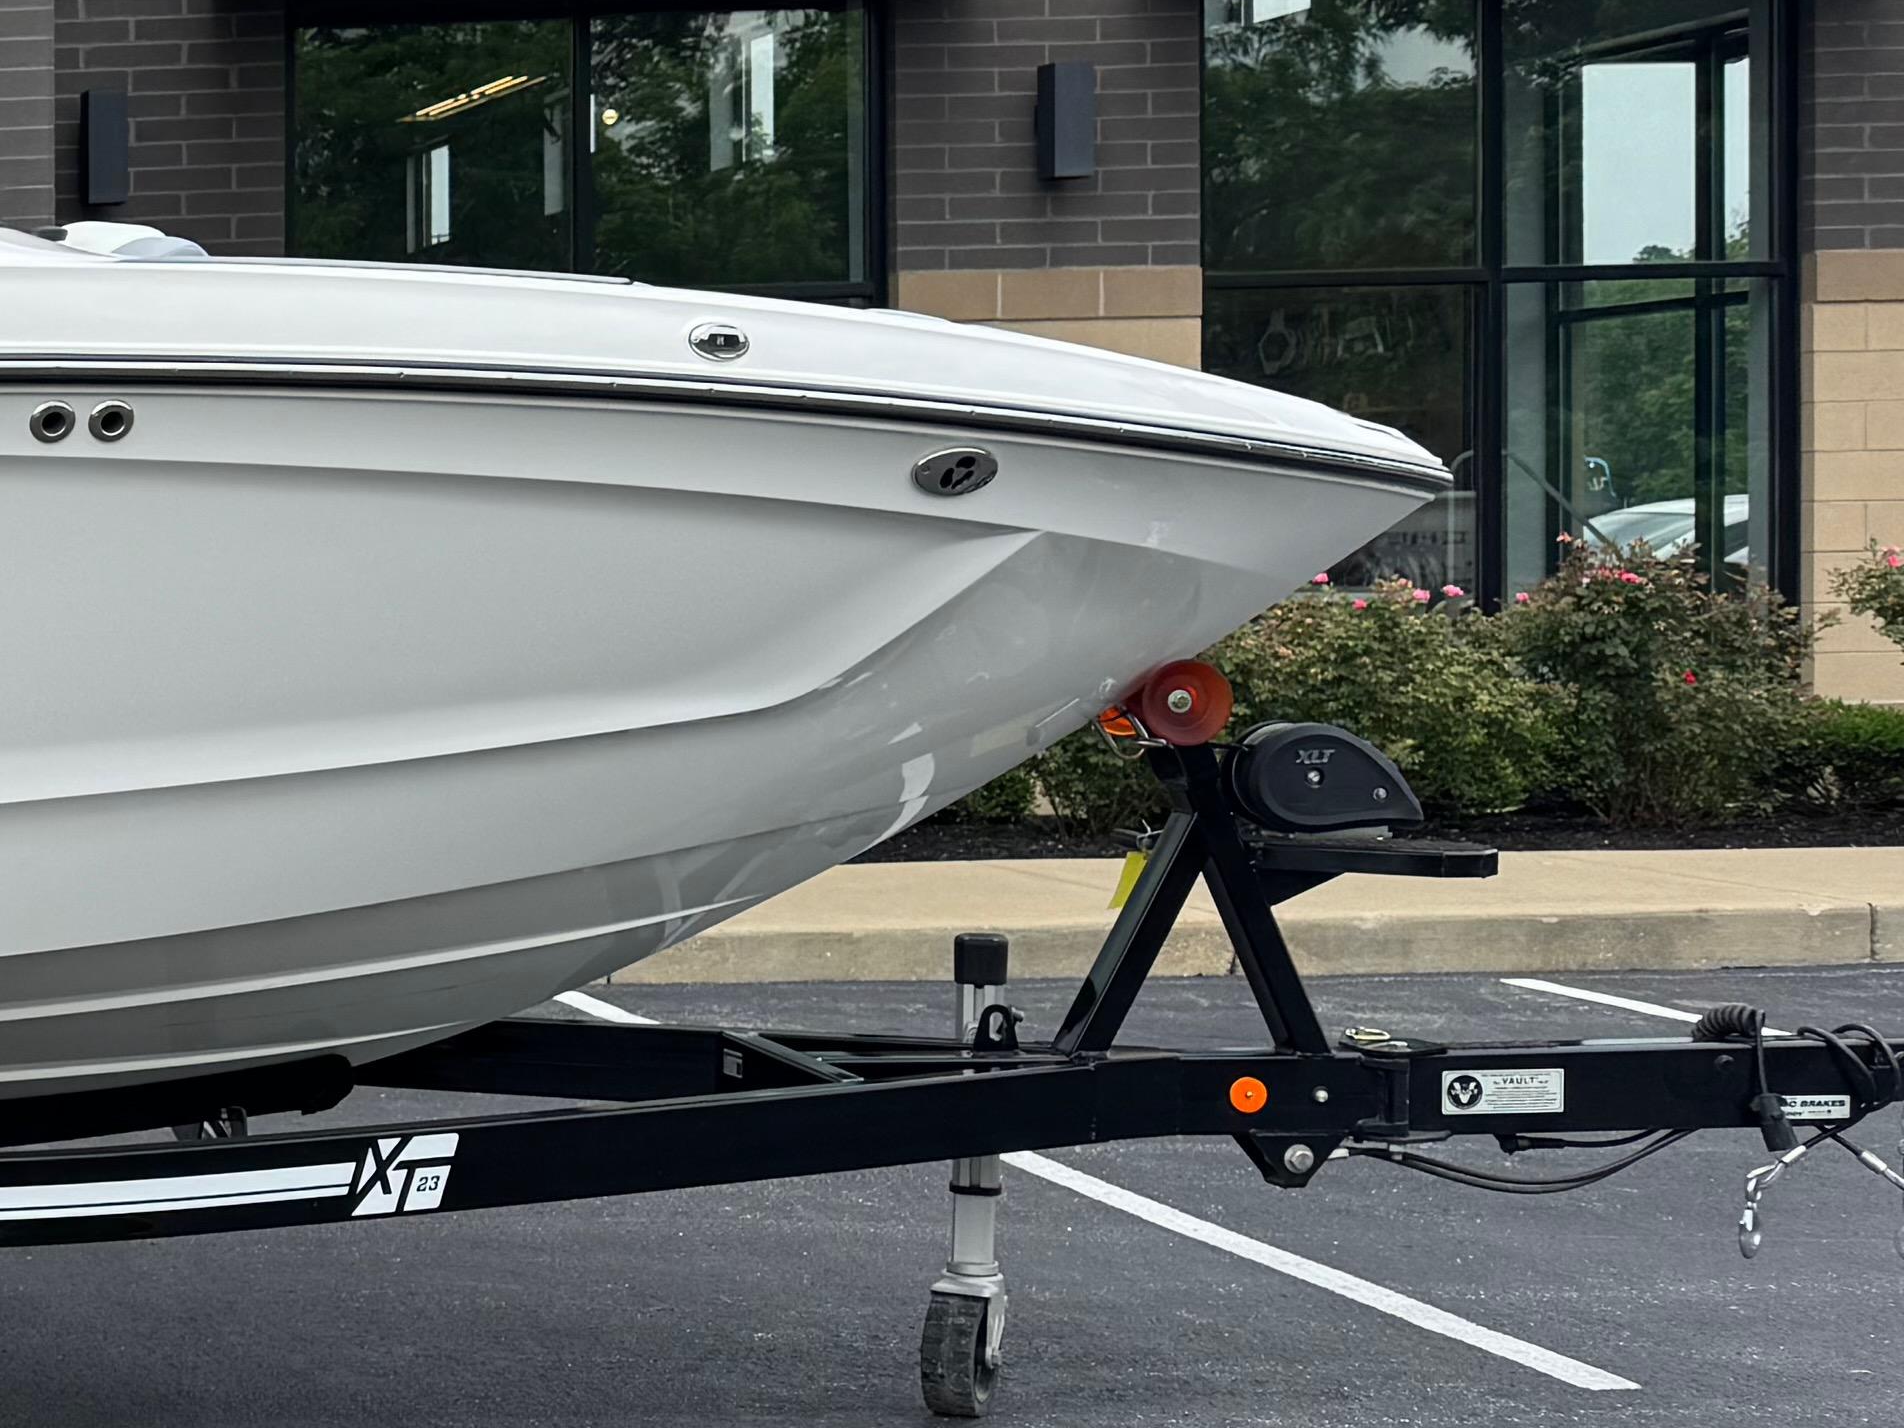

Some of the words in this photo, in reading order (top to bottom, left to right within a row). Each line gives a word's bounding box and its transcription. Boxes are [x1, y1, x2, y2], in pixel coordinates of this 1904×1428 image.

[1296, 748, 1335, 764] XLT
[1800, 1099, 1846, 1108] BRAKES
[416, 1175, 440, 1192] 23
